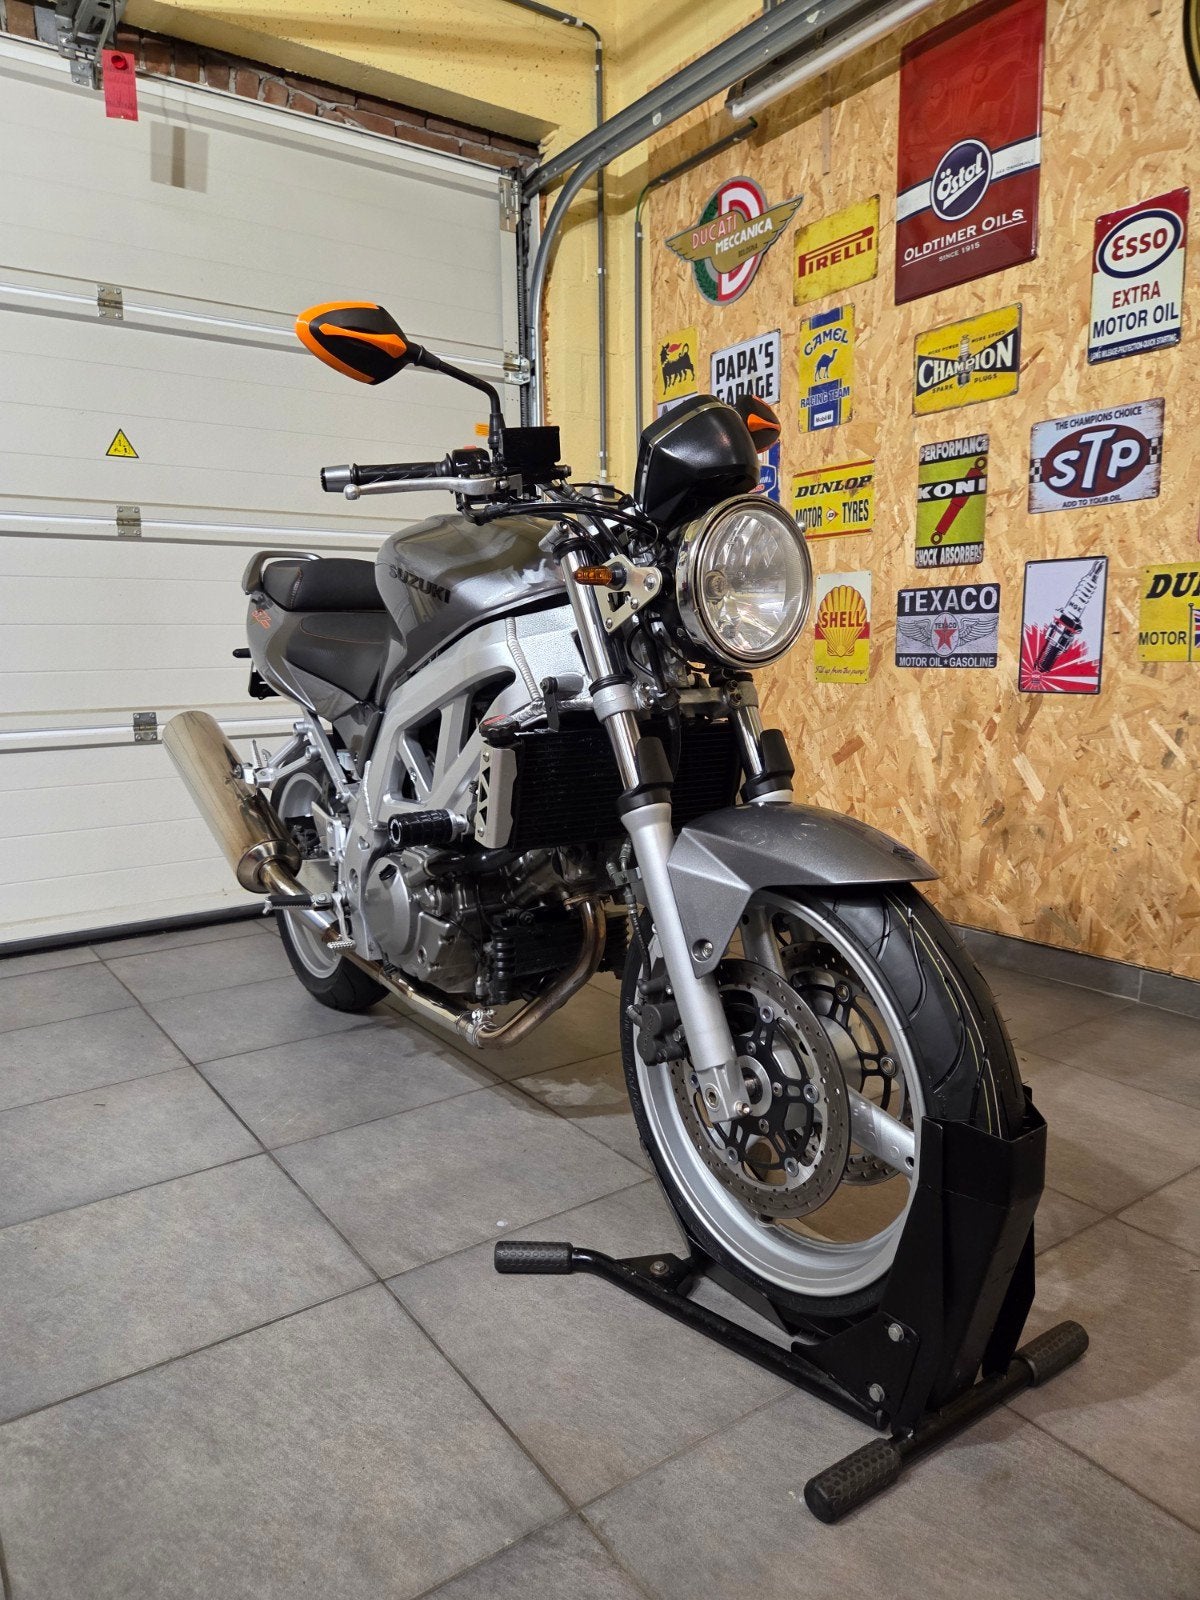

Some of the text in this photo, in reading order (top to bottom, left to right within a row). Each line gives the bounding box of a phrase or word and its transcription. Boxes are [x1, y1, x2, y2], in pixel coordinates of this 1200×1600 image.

[692, 214, 737, 249] DUCATI
[715, 217, 773, 255] MECCANICA
[904, 209, 1025, 261] OLDTIMER OILS
[798, 226, 874, 278] PIRELLI
[939, 241, 981, 261] SINCE 1915
[1112, 281, 1161, 309] EXTRA
[1093, 302, 1179, 339] MOTOR OIL
[804, 328, 849, 356] CAMEL
[715, 341, 774, 386] PAPA'S
[918, 333, 1014, 388] CHAMPION
[932, 373, 998, 394] SPARK PLUGS
[800, 385, 850, 409] RACING TEAM
[1055, 406, 1142, 431] THE CHAMPIONS CHOICE
[920, 434, 990, 462] PERFORMANCE
[1049, 428, 1140, 490] STP
[795, 475, 873, 498] DUNLOP
[918, 478, 987, 500] KONI
[842, 499, 869, 524] TYRES
[1062, 500, 1078, 508] ADD
[1089, 496, 1109, 505] YOUR
[1109, 494, 1121, 502] OIL
[795, 505, 823, 528] MOTOR
[915, 544, 984, 567] SHOCK ABSORBERS
[389, 564, 451, 604] SUZUKI
[900, 586, 998, 613] TEXACO
[1069, 601, 1082, 612] NGK
[821, 610, 863, 629] SHELL
[1139, 631, 1187, 646] MOTOR
[899, 656, 995, 668] MOTOR OIL GASOLINE
